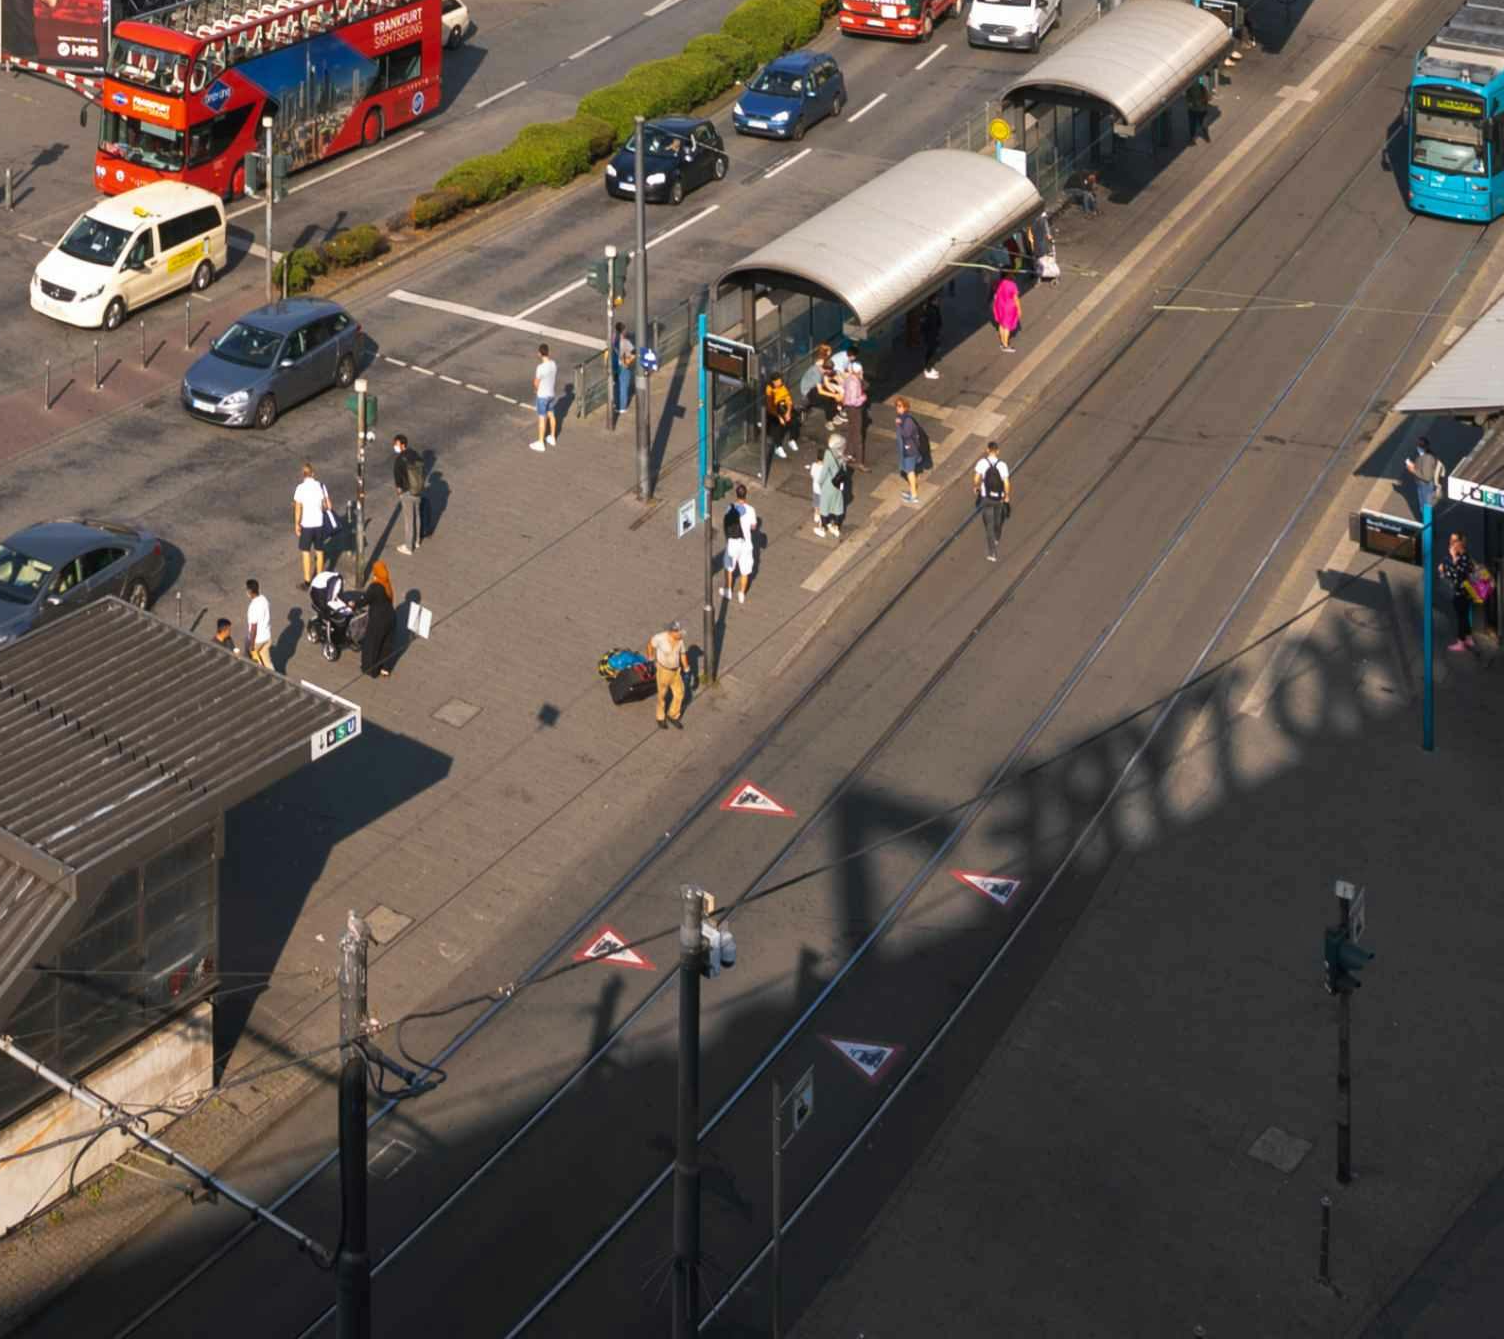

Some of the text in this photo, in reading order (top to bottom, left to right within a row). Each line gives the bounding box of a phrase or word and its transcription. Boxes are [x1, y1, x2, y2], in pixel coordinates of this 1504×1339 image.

[374, 7, 423, 36] FRANKFURT
[374, 25, 423, 49] SIGHTSEEING
[72, 44, 99, 57] HRS
[1422, 95, 1431, 107] 11
